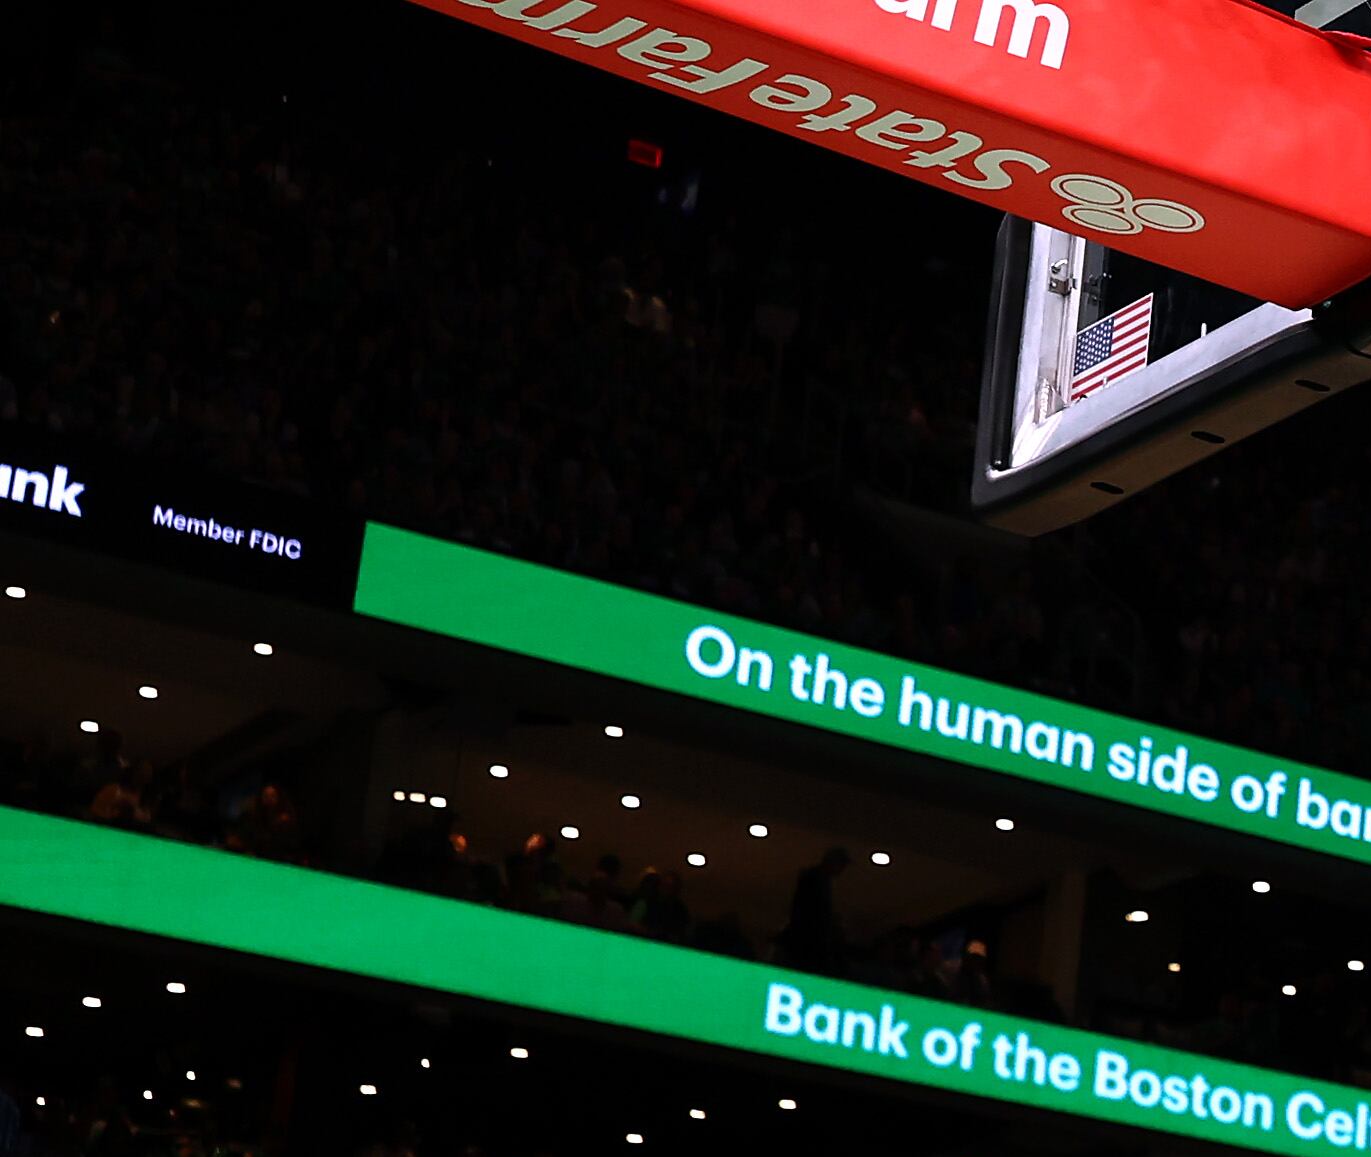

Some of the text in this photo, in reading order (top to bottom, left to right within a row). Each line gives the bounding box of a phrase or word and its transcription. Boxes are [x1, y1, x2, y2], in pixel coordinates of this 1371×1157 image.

[152, 504, 245, 545] Member
[249, 529, 302, 560] FDIC
[686, 626, 773, 690] On
[790, 655, 885, 716] the
[899, 676, 1094, 770] human
[1108, 738, 1219, 801] side
[1231, 772, 1287, 817] of
[766, 984, 907, 1057] Bank
[923, 1024, 981, 1069] of
[994, 1033, 1080, 1090] the
[1095, 1051, 1273, 1129] Boston
